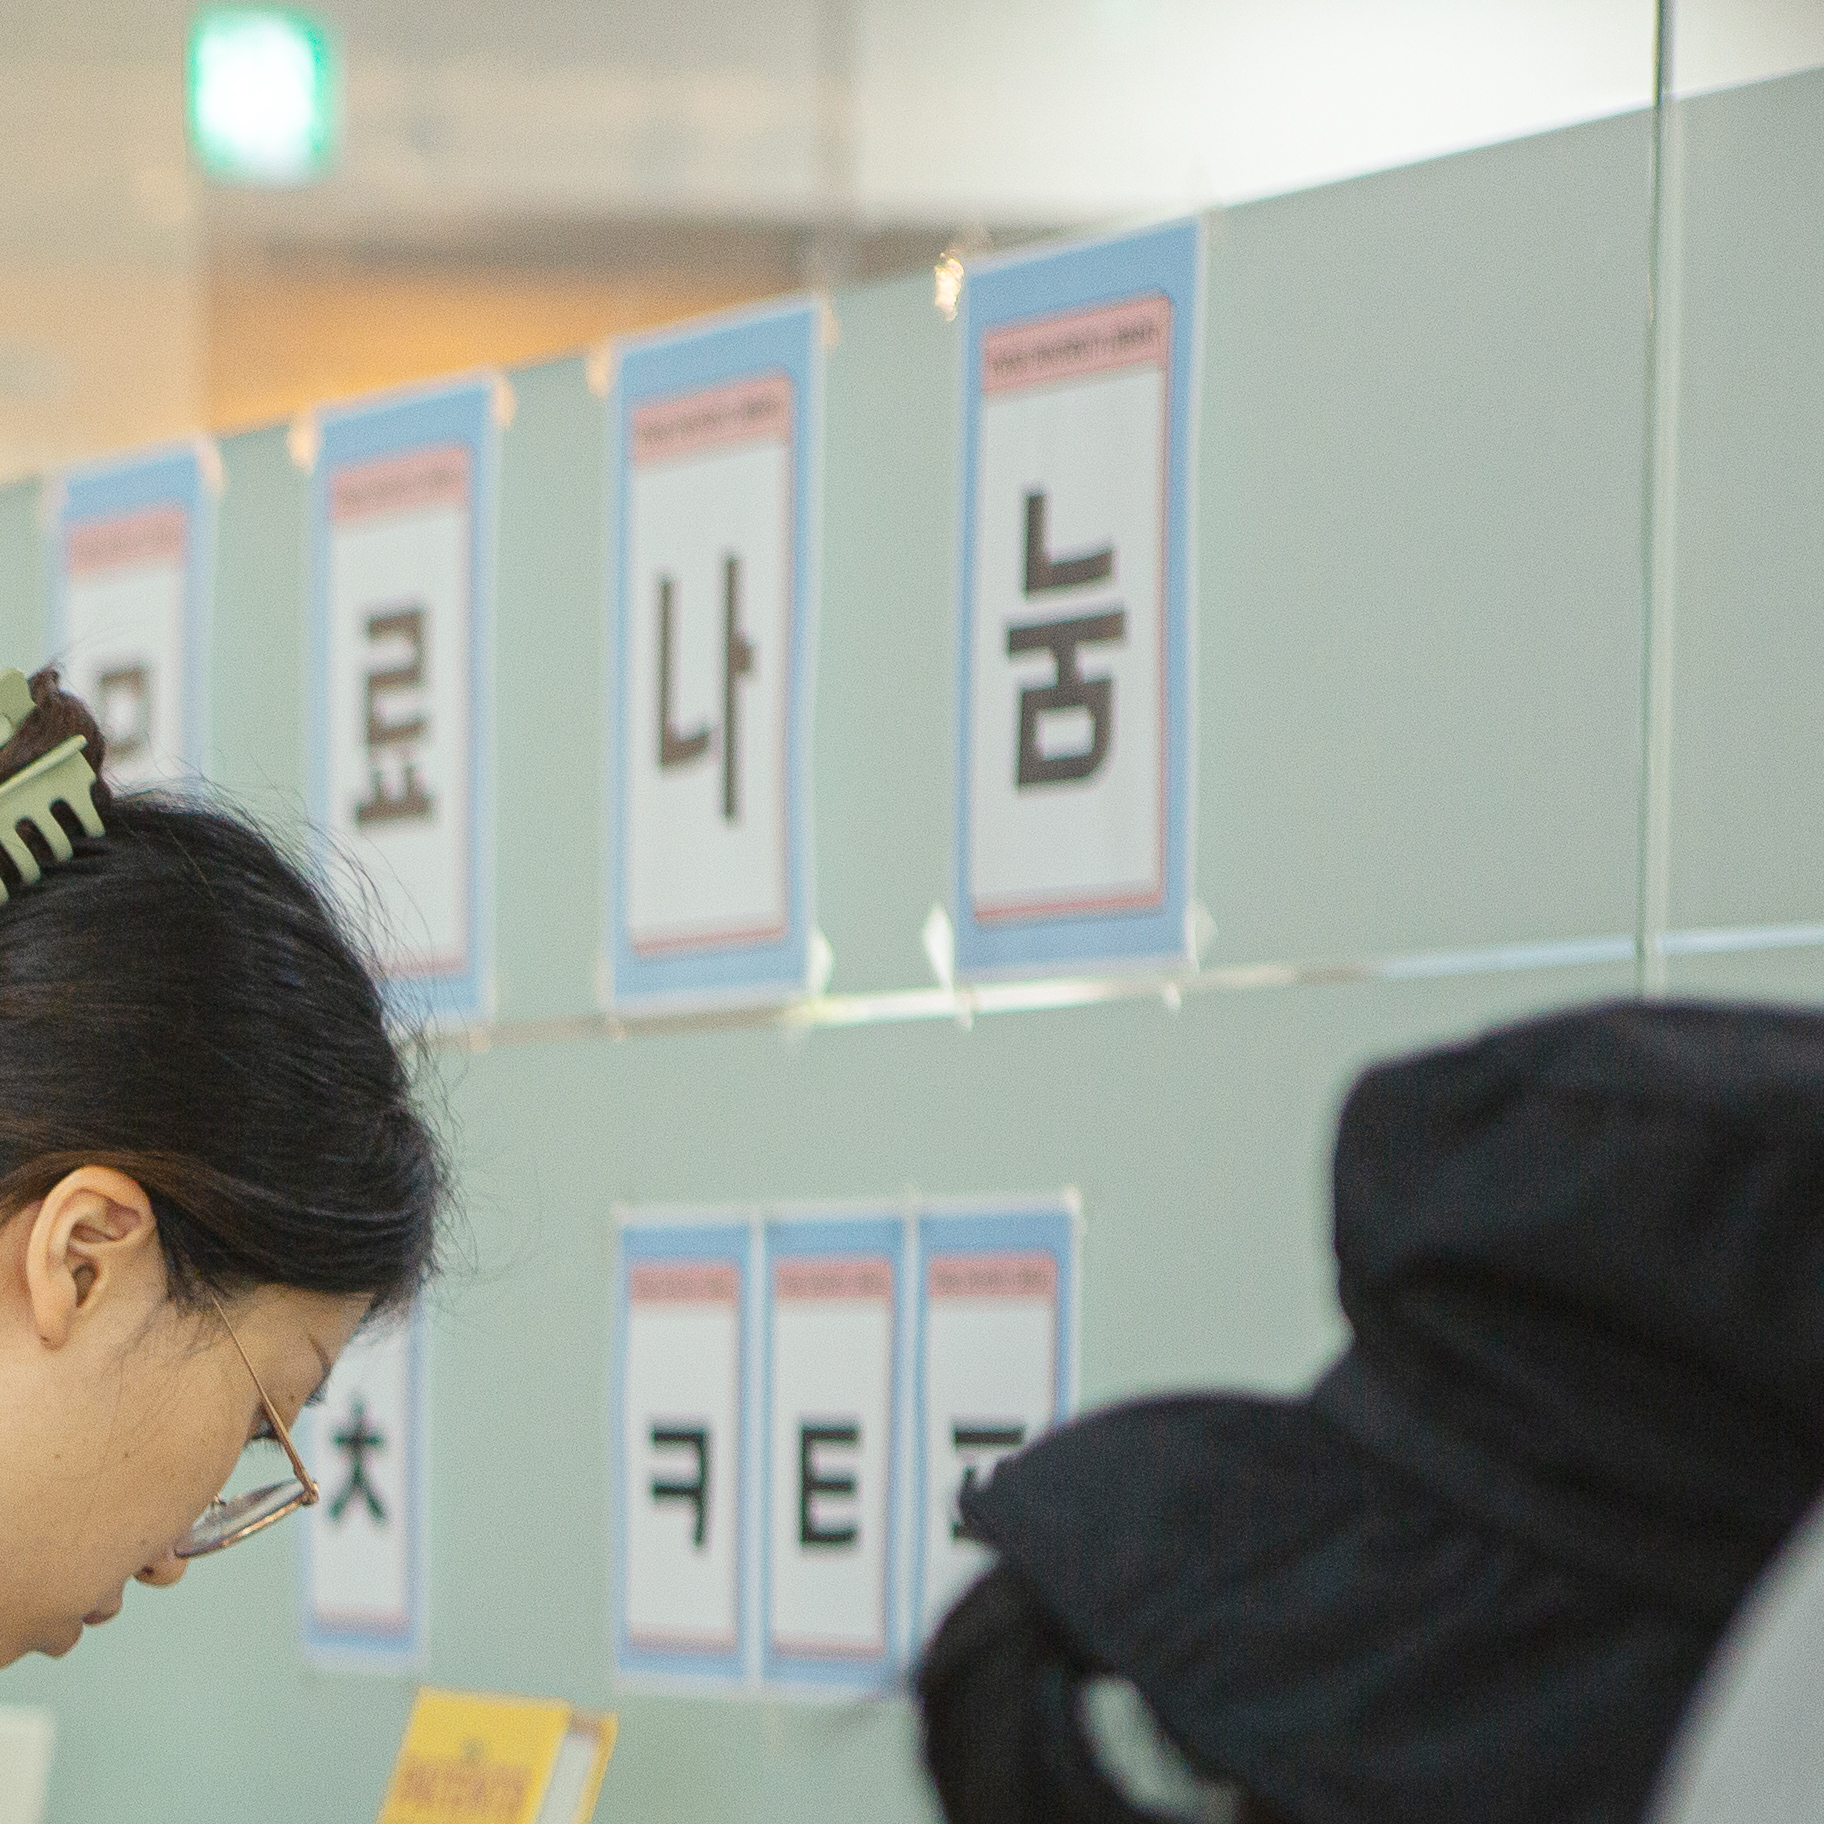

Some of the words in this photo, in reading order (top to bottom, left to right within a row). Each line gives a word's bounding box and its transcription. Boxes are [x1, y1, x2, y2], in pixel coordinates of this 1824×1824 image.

[353, 604, 436, 829] 료
[654, 549, 756, 825] 나
[1004, 488, 1129, 797] 눔
